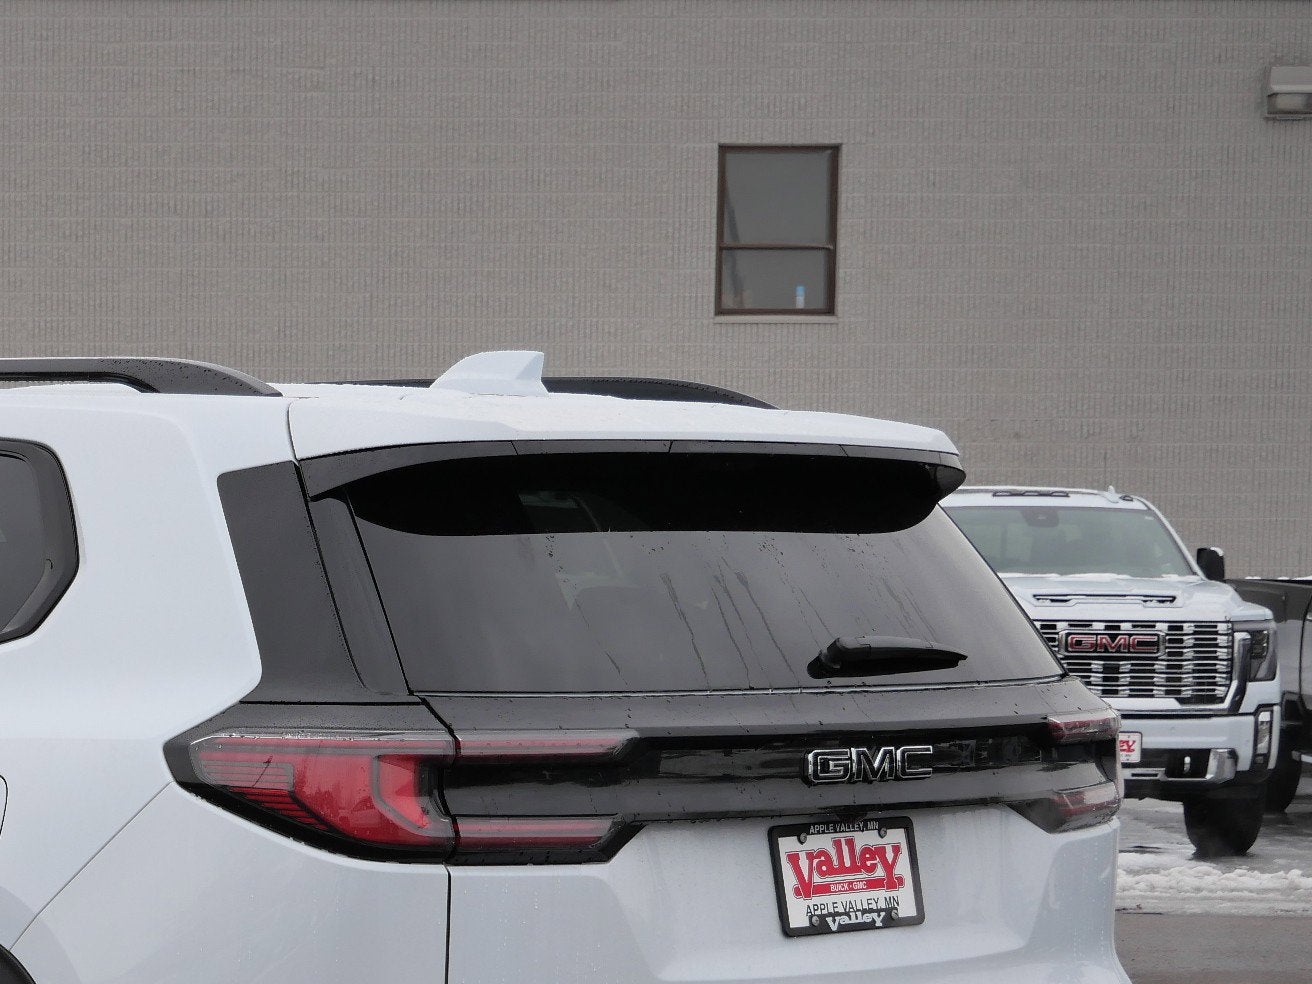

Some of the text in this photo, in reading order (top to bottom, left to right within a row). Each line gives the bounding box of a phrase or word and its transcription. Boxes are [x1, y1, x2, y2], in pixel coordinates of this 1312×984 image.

[1068, 634, 1158, 652] GMC
[807, 745, 933, 783] GMC
[809, 824, 834, 834] APPLE
[867, 821, 879, 830] MN
[830, 881, 867, 892] BUICK GMC
[806, 901, 838, 916] APPLE
[884, 895, 900, 909] MN
